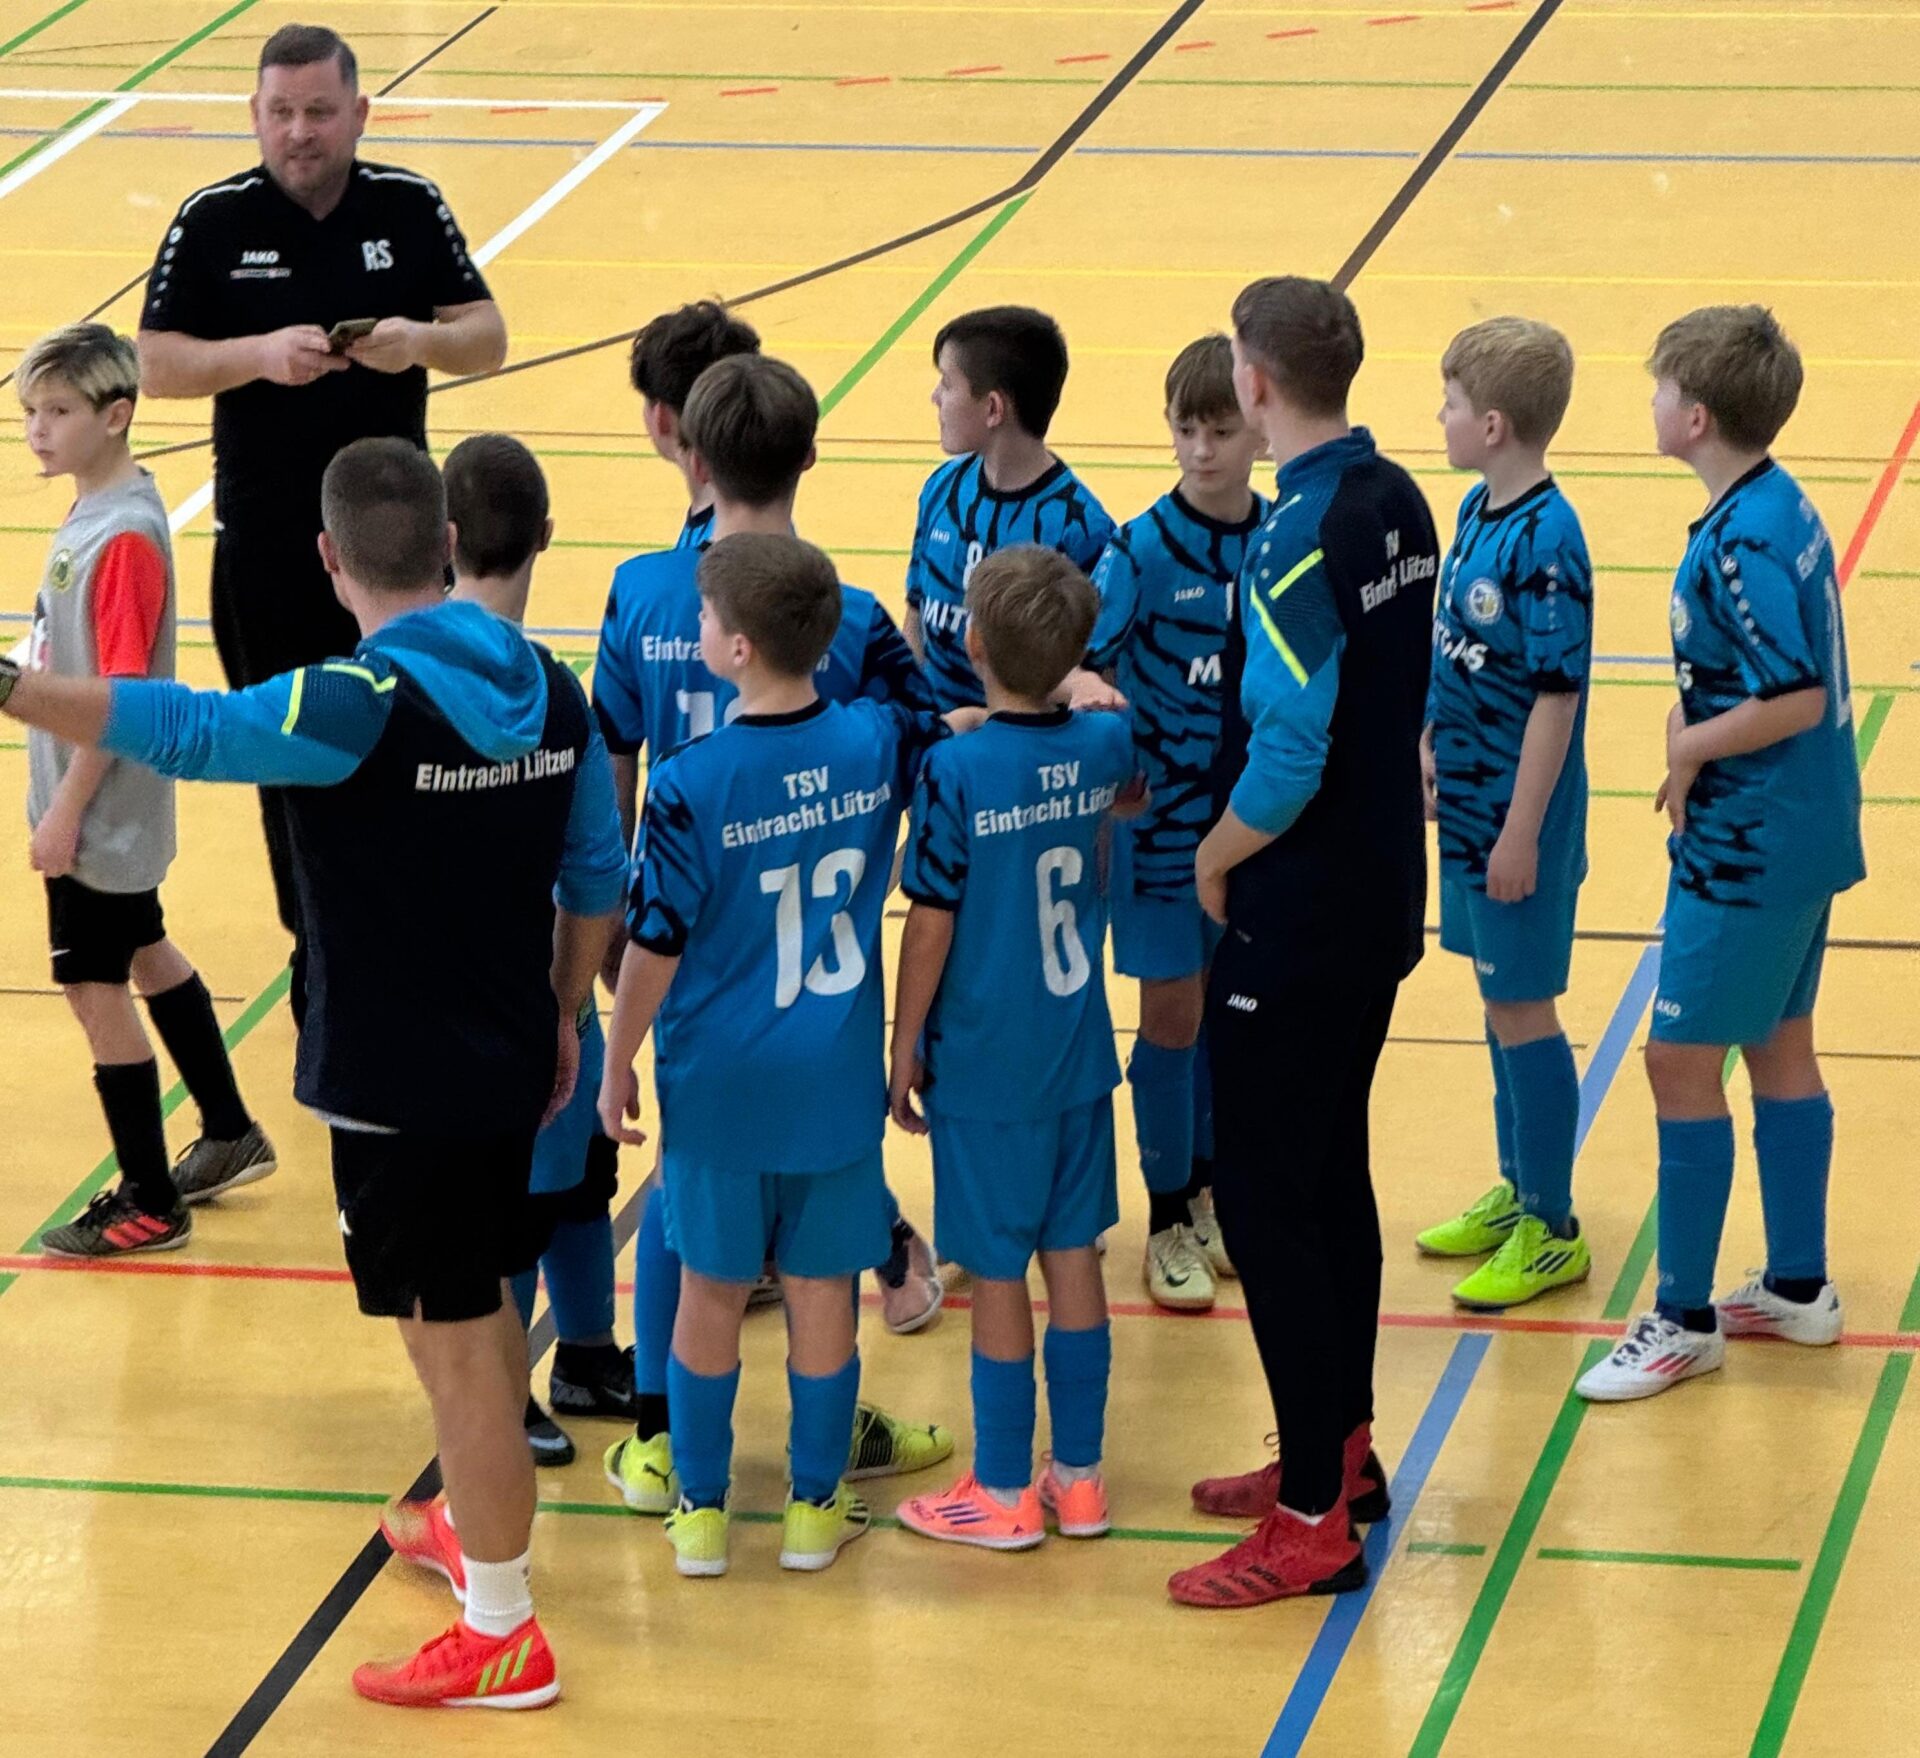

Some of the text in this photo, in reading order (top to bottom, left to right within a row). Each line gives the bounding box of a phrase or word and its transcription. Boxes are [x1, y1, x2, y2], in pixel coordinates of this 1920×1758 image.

[361, 239, 394, 271] RS
[641, 635, 703, 662] Eintra
[415, 746, 575, 792] Eintracht Lützen
[783, 765, 829, 800] TSV
[1037, 760, 1081, 792] TSV
[722, 803, 827, 849] Eintracht
[759, 847, 867, 1009] 13
[1036, 846, 1091, 997] 6
[1227, 993, 1258, 1012] JAKO
[1656, 999, 1682, 1018] AKO
